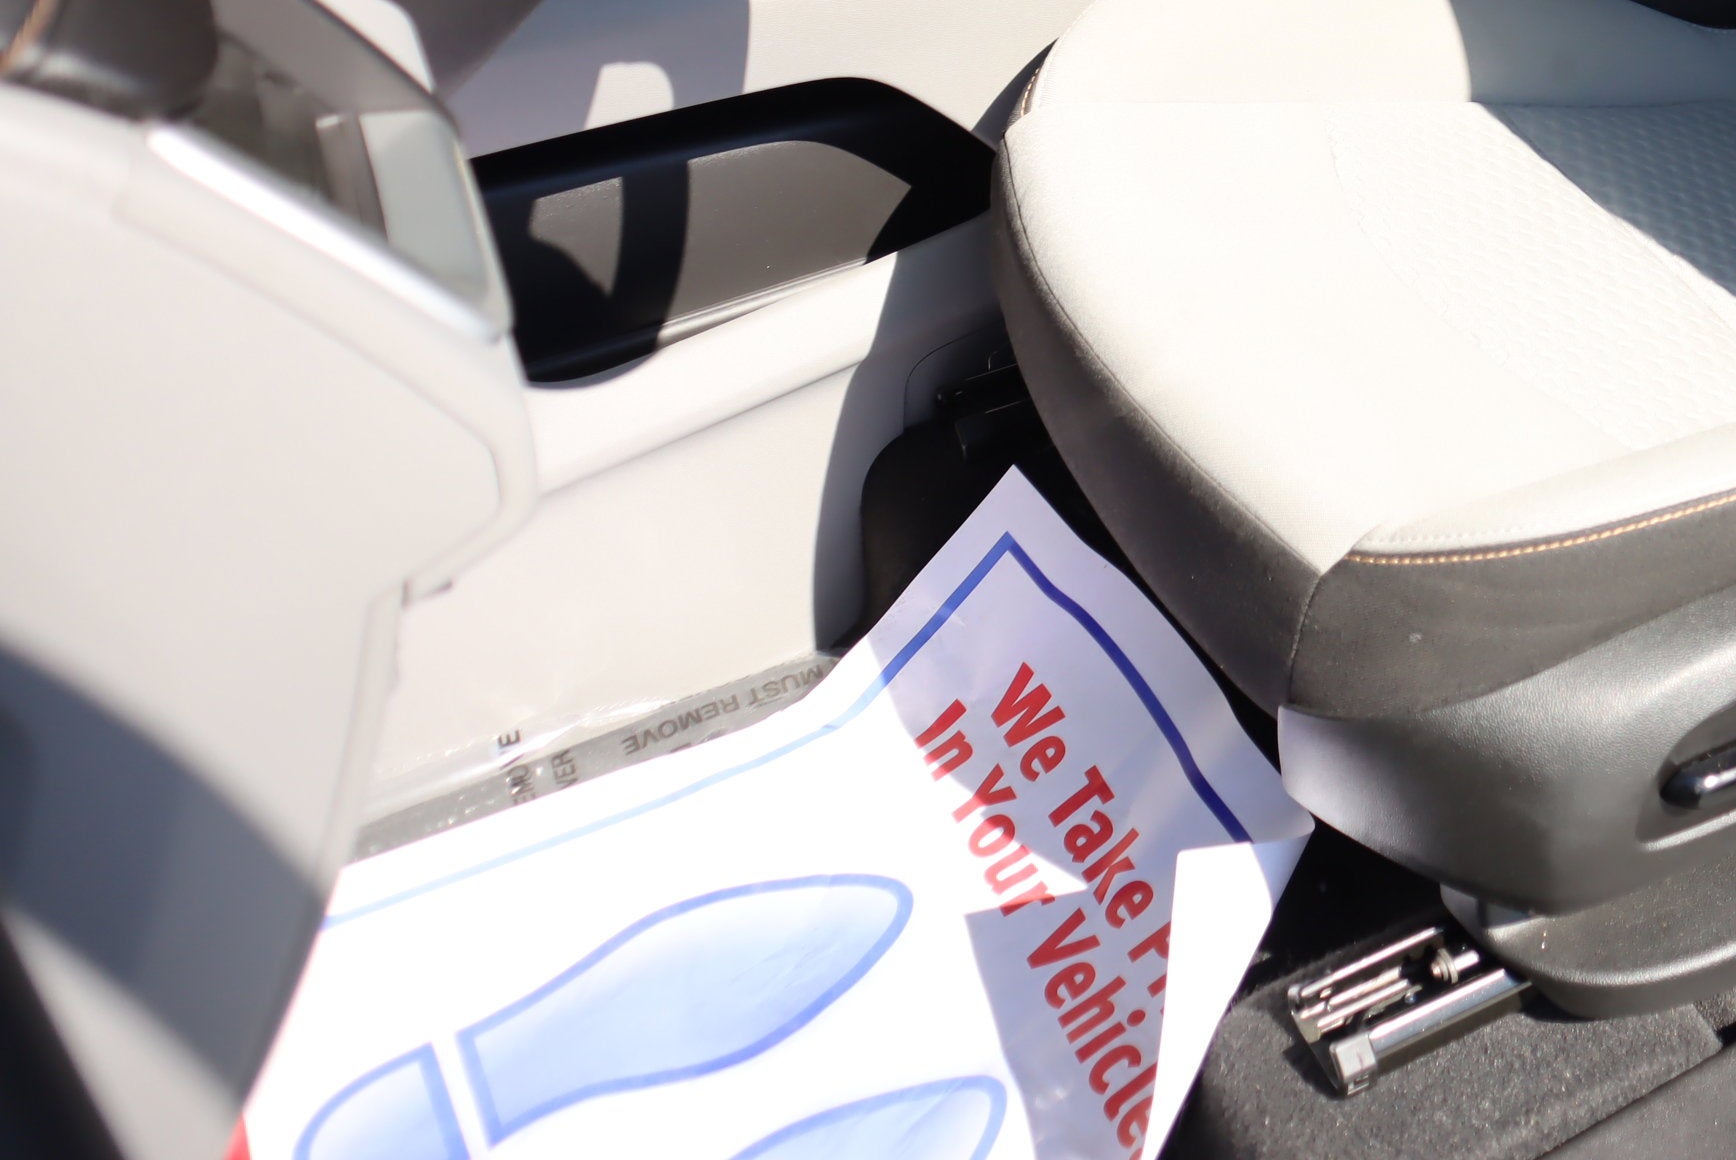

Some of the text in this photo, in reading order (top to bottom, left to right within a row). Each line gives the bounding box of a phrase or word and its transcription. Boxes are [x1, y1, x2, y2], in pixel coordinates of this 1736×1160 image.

[621, 695, 741, 757] REMOVE
[750, 664, 824, 708] MUST
[990, 661, 1066, 782] We
[1048, 764, 1154, 929] Take
[913, 698, 974, 782] In
[951, 762, 1056, 918] Your
[1026, 907, 1158, 1160] Vehicle
